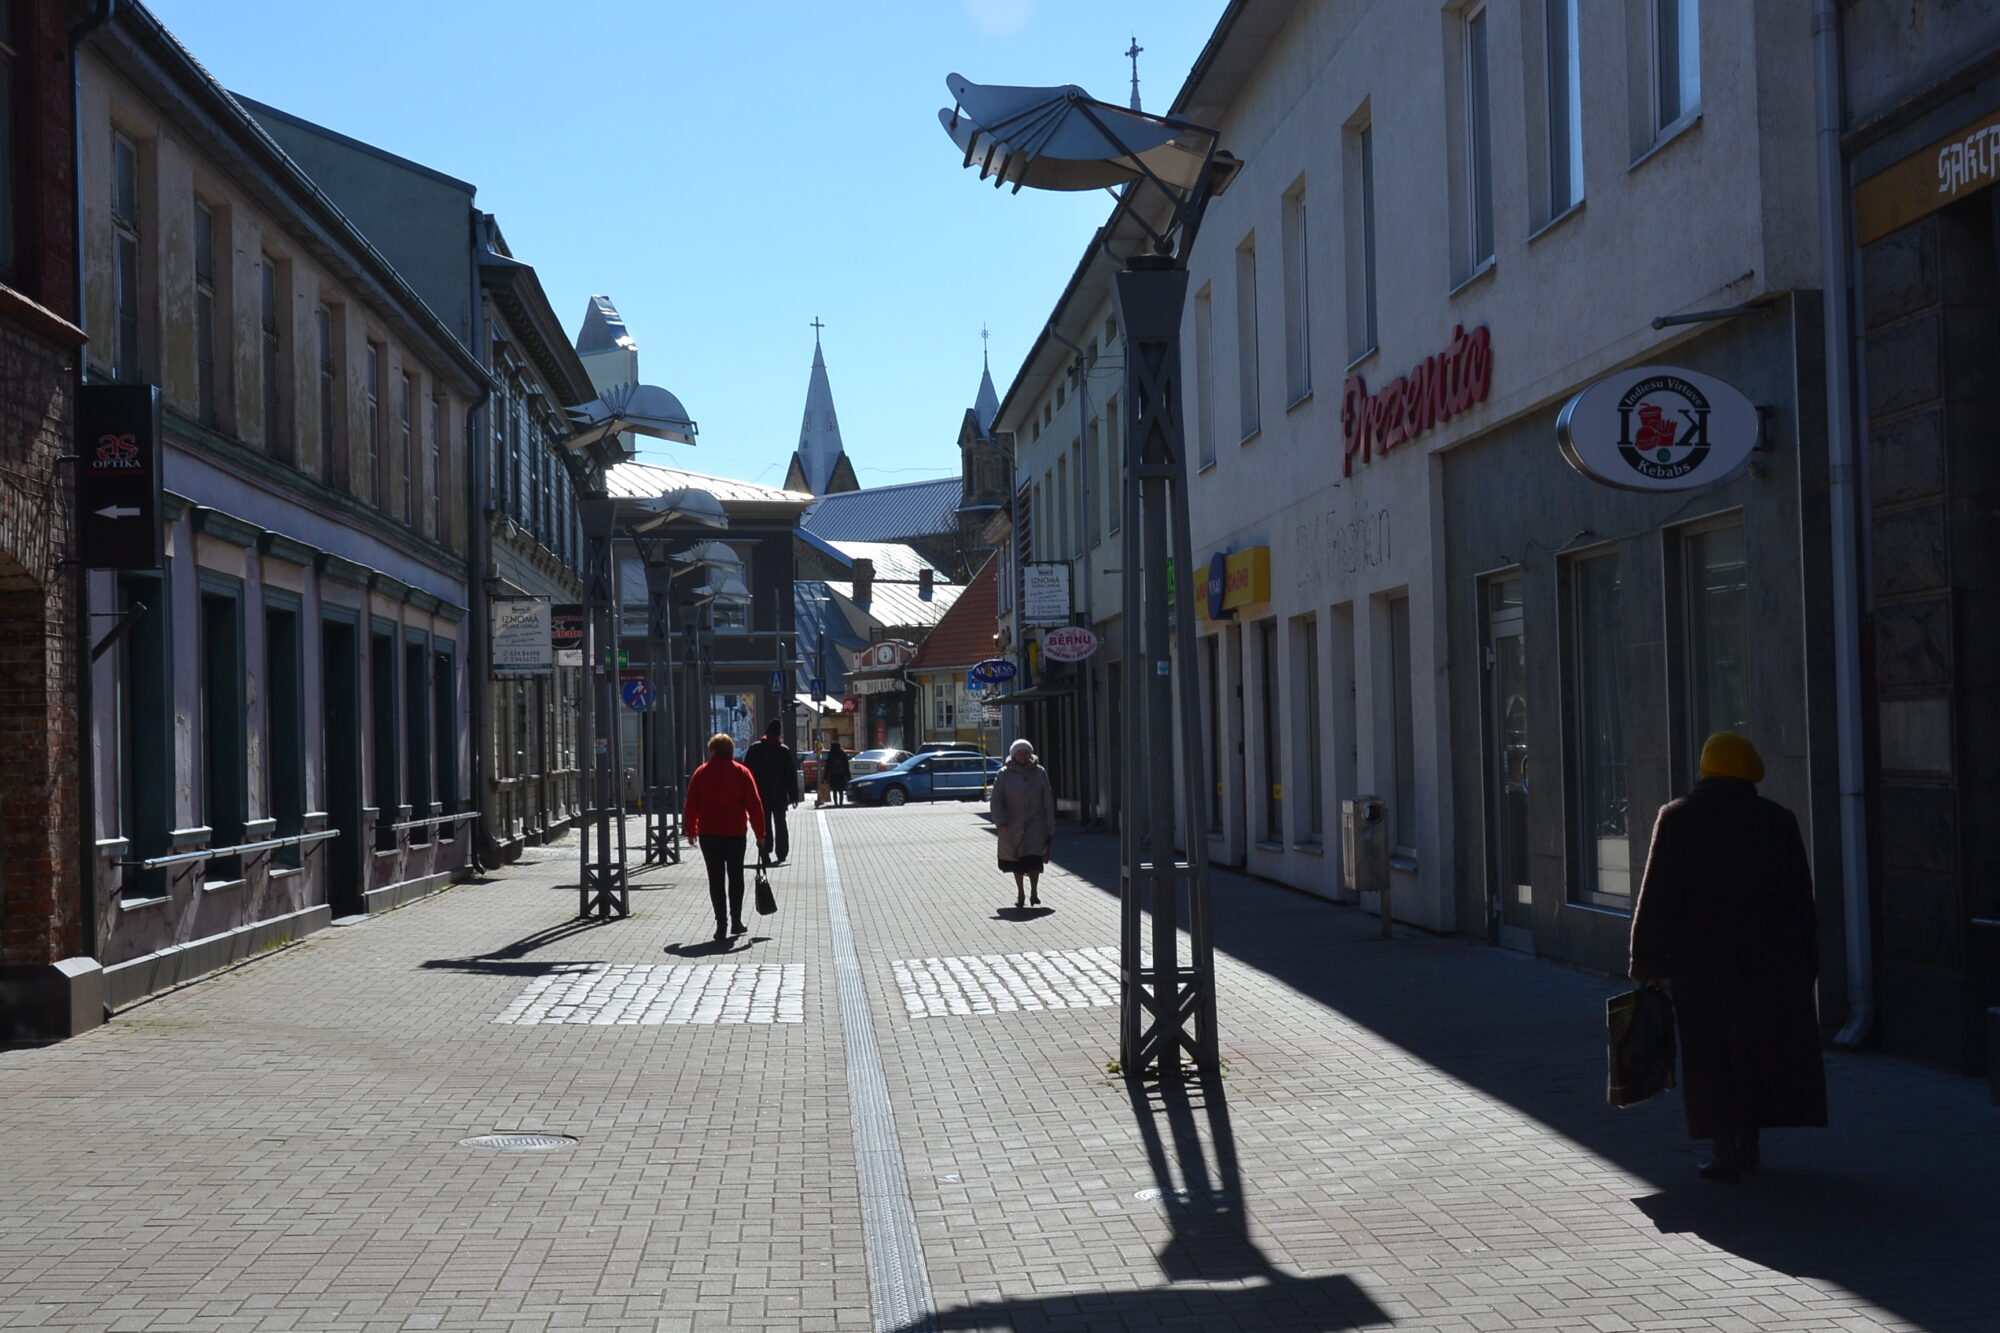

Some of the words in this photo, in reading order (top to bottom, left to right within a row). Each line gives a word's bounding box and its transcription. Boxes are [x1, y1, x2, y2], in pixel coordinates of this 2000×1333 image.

[1667, 378, 1703, 407] Virtuve
[92, 459, 142, 469] OPTIKA
[1637, 459, 1691, 478] Kebabs
[502, 614, 539, 623] IZNOMĀ
[1049, 633, 1091, 646] BĒRNU
